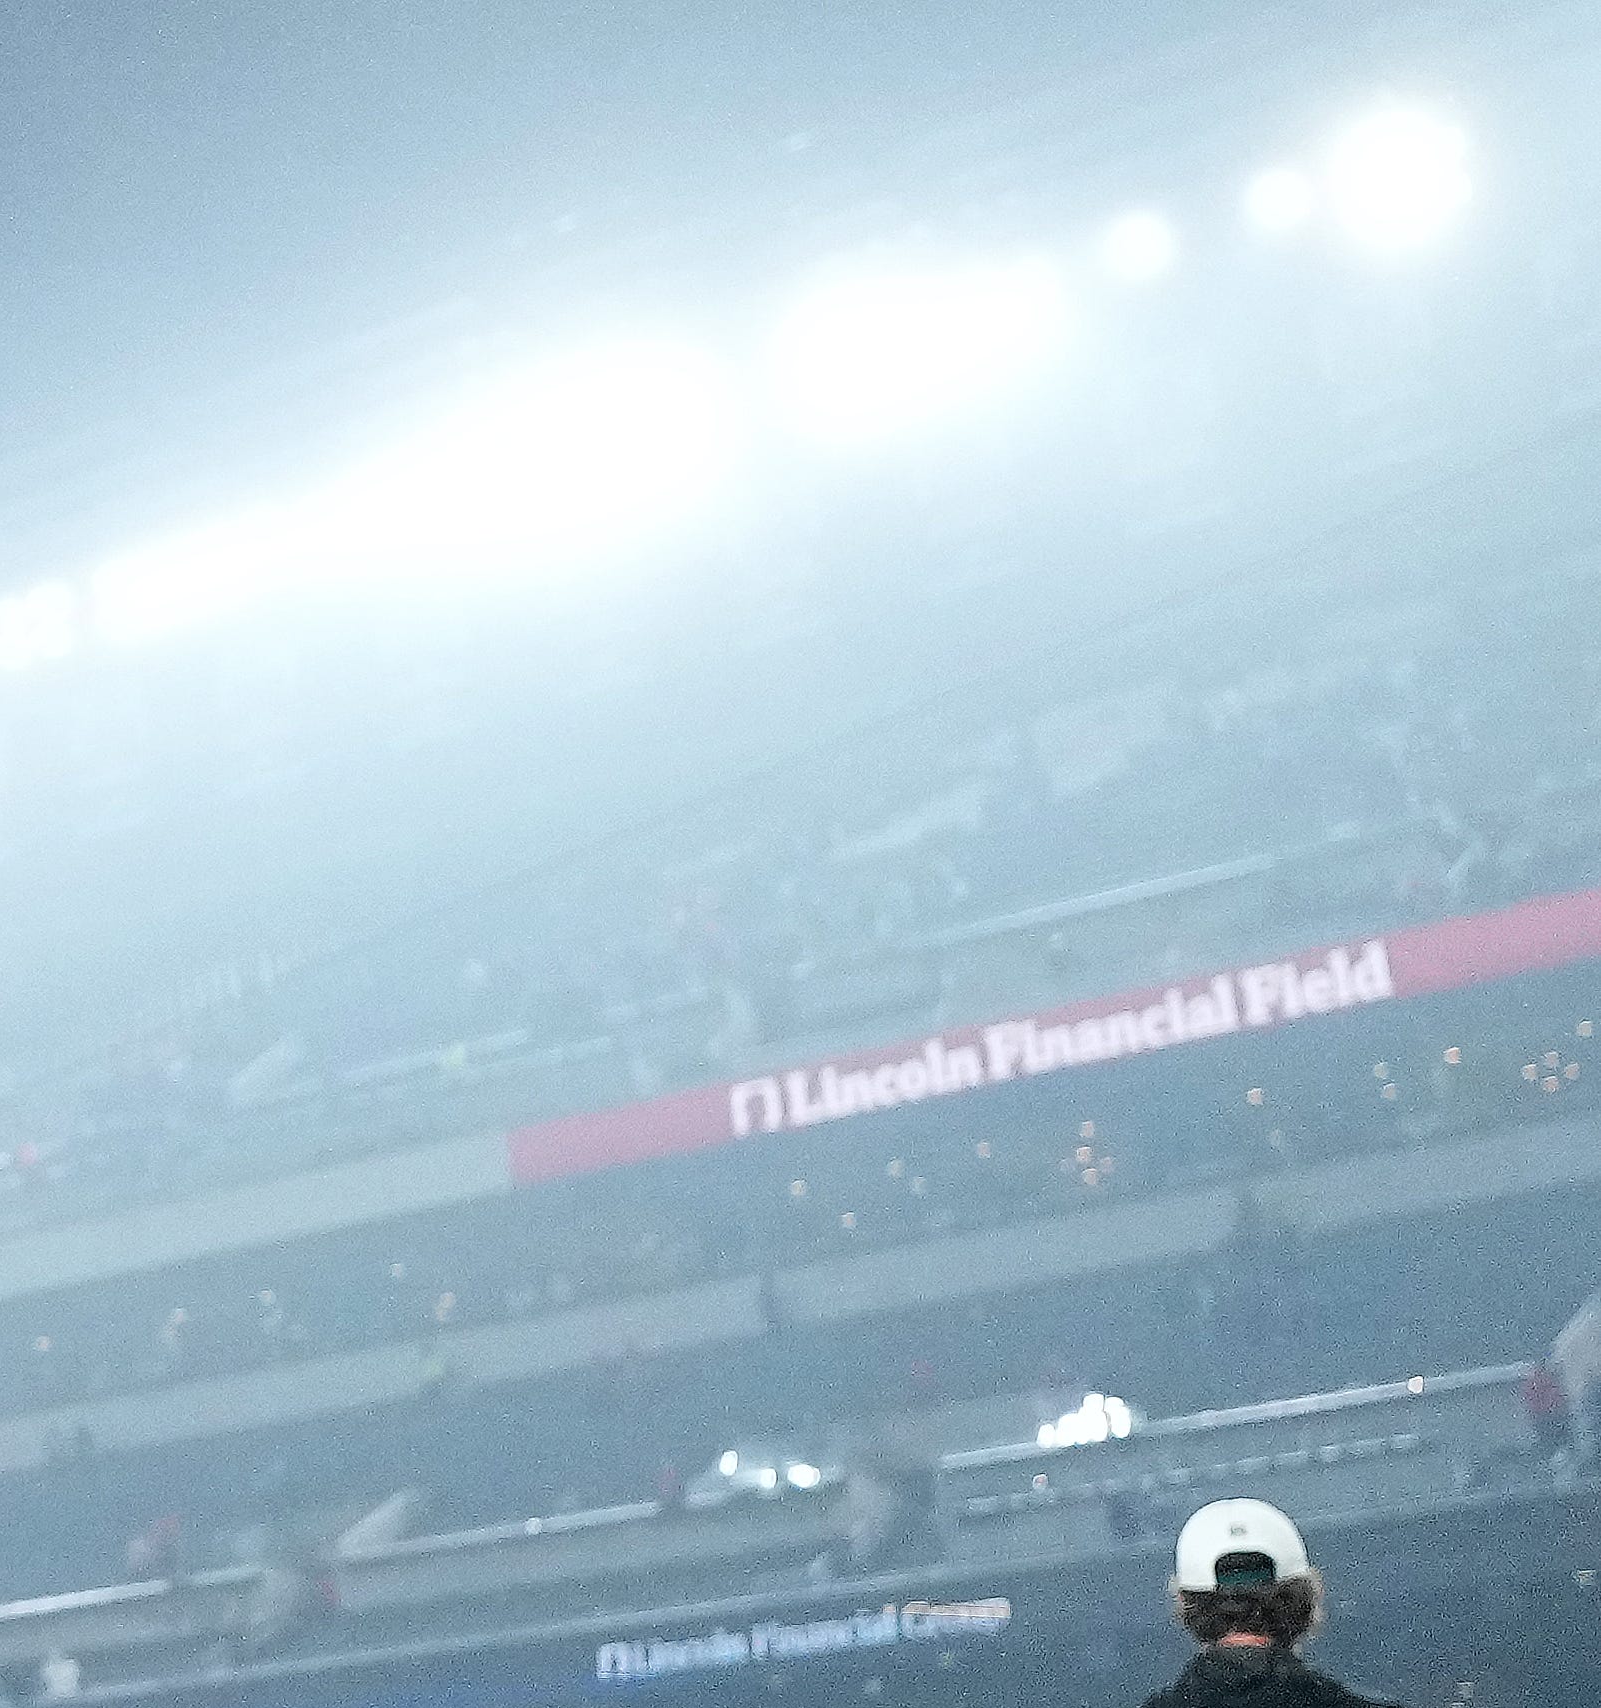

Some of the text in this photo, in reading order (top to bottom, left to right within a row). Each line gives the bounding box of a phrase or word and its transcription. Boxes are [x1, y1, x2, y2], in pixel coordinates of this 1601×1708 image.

[786, 939, 1392, 1128] Lincoln Financial Field
